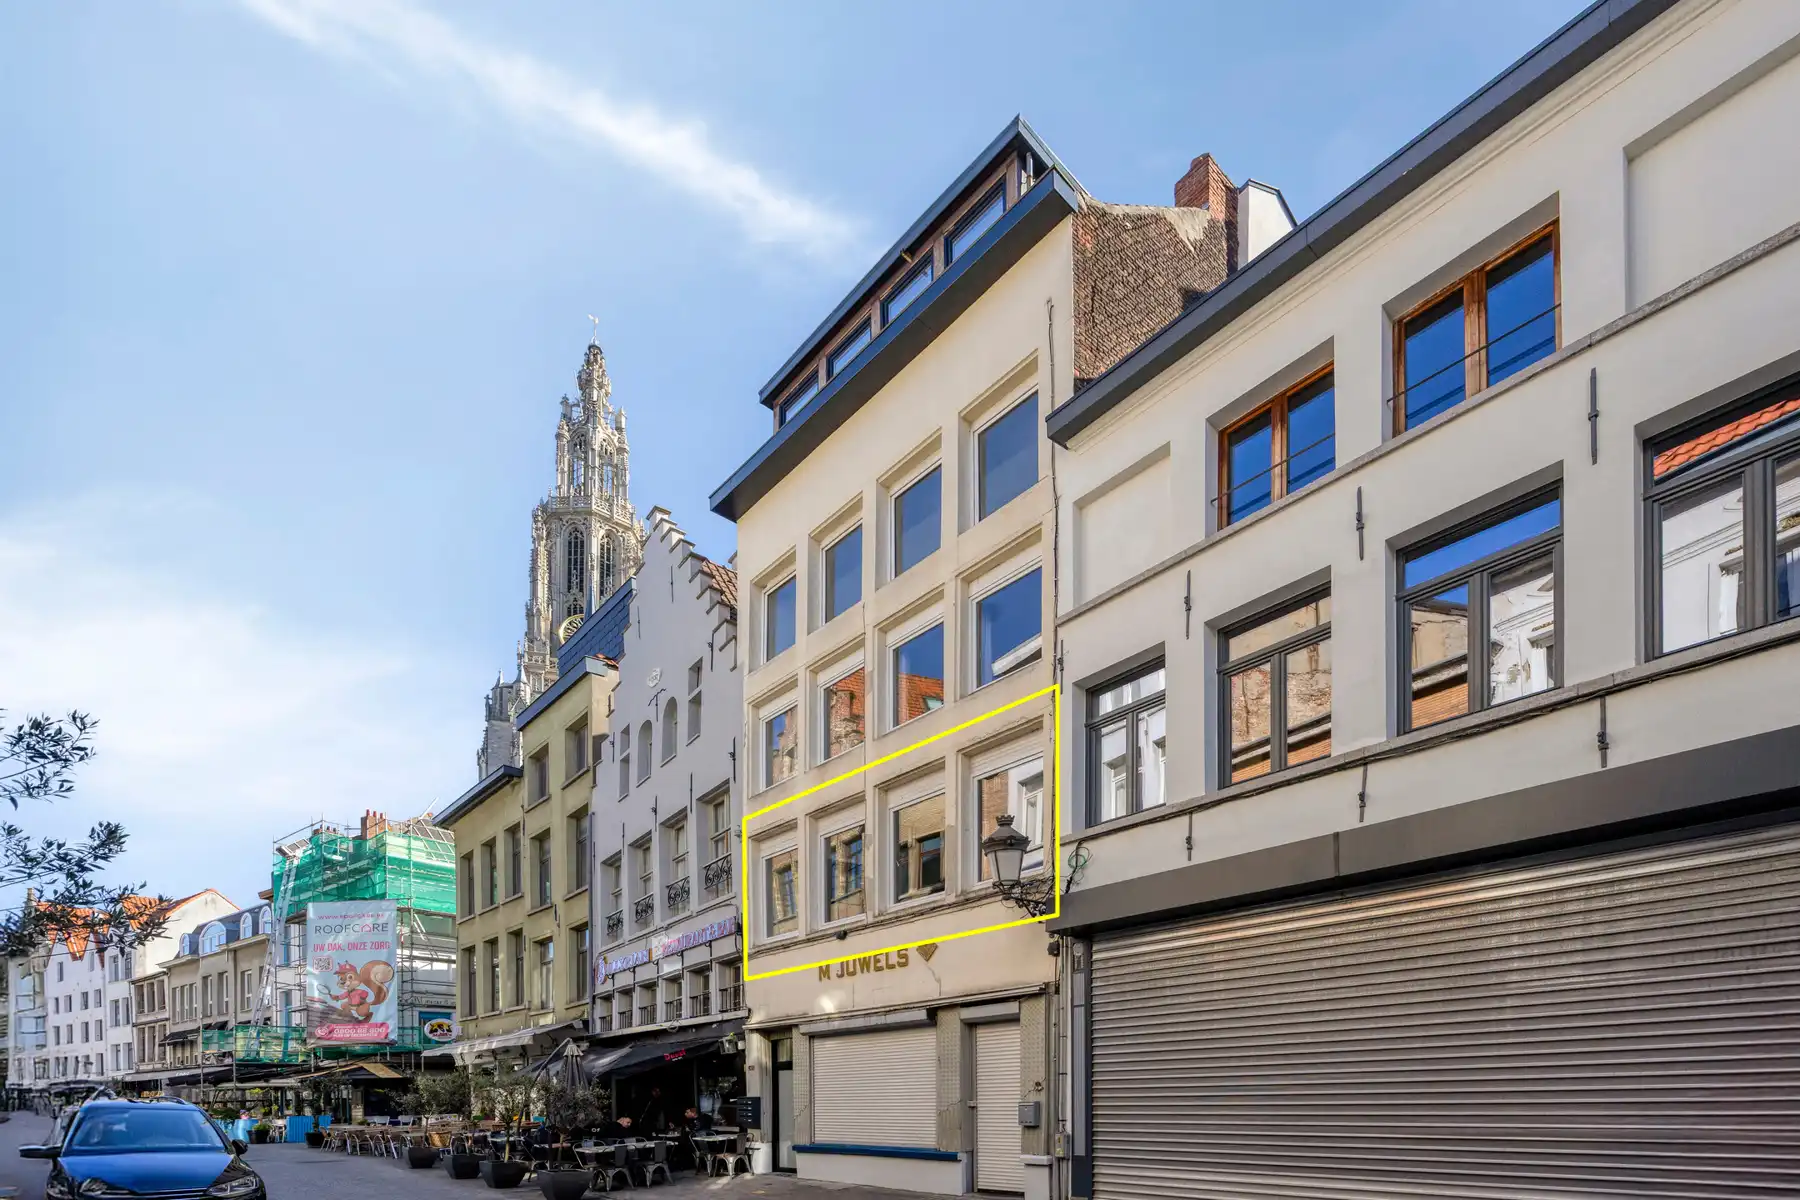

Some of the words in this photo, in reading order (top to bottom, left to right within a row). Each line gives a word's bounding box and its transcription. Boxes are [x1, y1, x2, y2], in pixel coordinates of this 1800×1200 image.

[313, 943, 325, 953] UW
[347, 941, 368, 951] ONZE
[369, 941, 392, 950] ZORG
[836, 948, 909, 978] JUWELS
